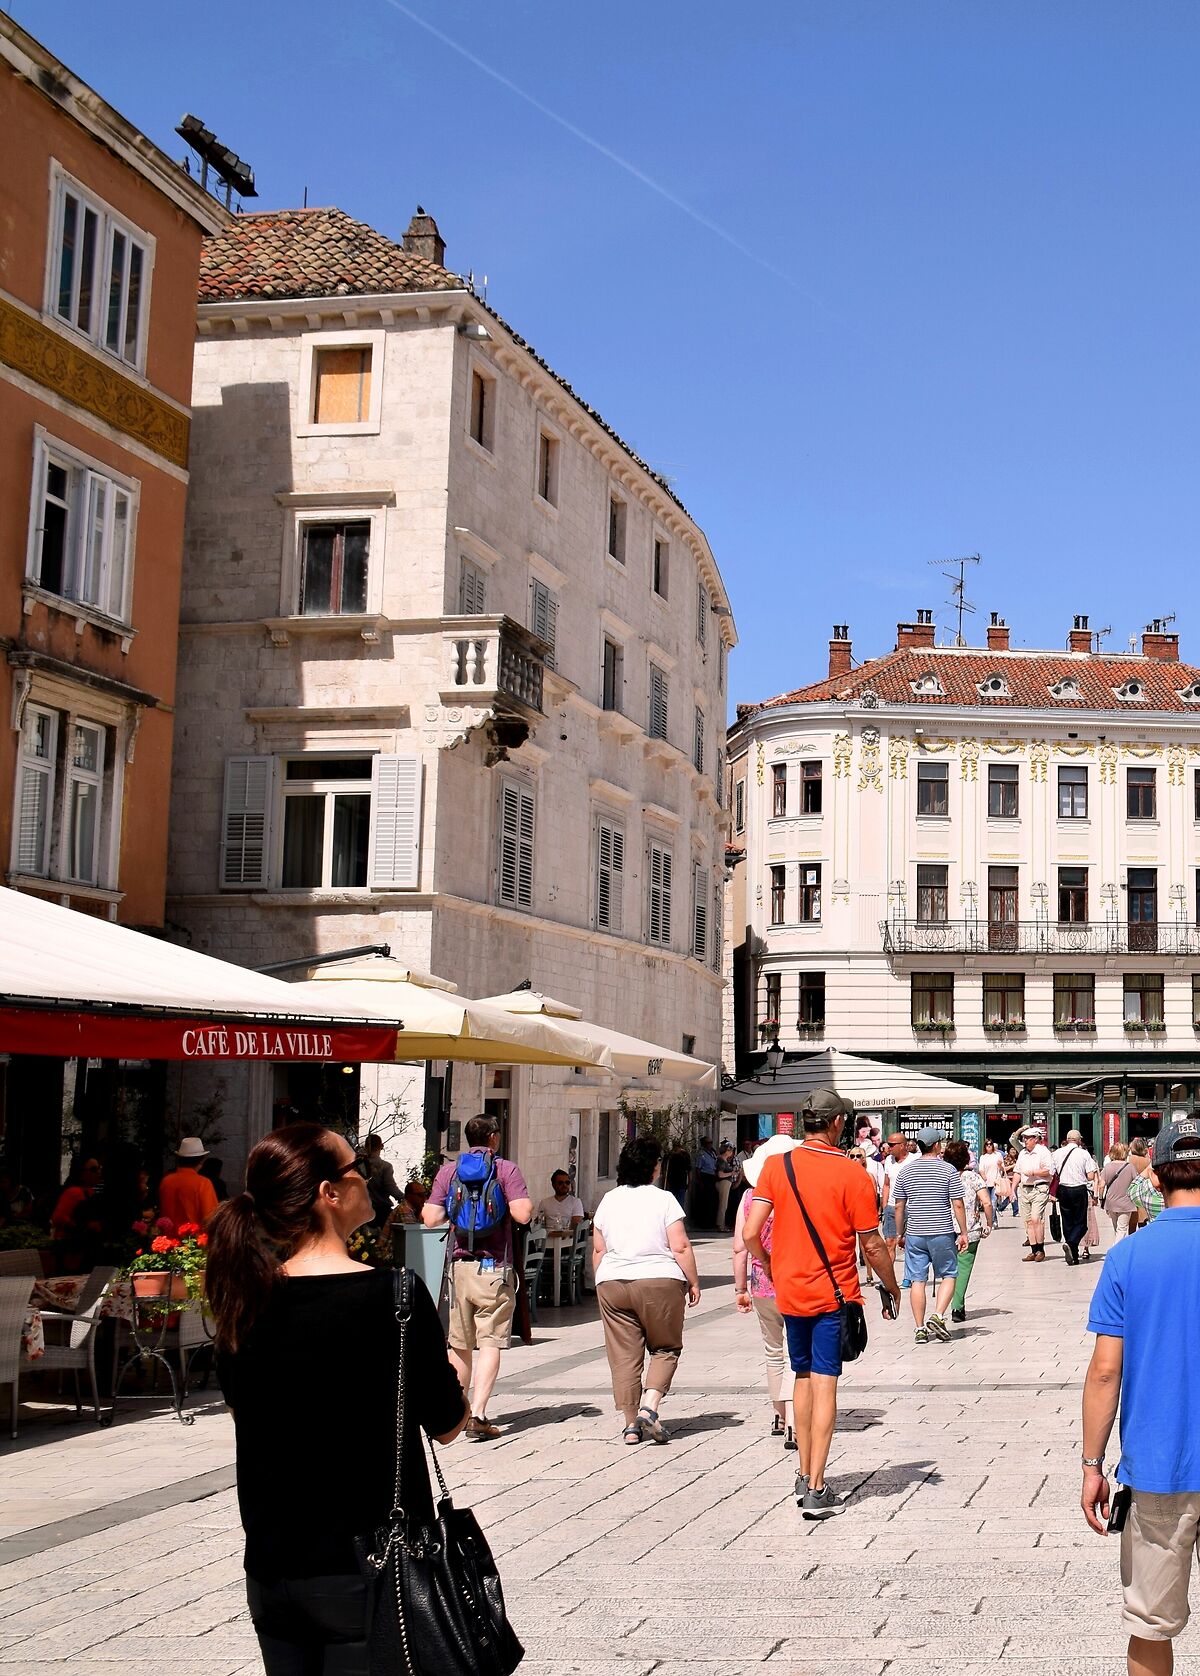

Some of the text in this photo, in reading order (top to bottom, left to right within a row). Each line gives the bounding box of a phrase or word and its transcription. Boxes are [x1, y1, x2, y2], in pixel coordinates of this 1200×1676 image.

[234, 1032, 258, 1056] DE
[262, 1032, 284, 1056] LA
[286, 1033, 332, 1056] VILLE
[872, 1098, 896, 1106] Judita
